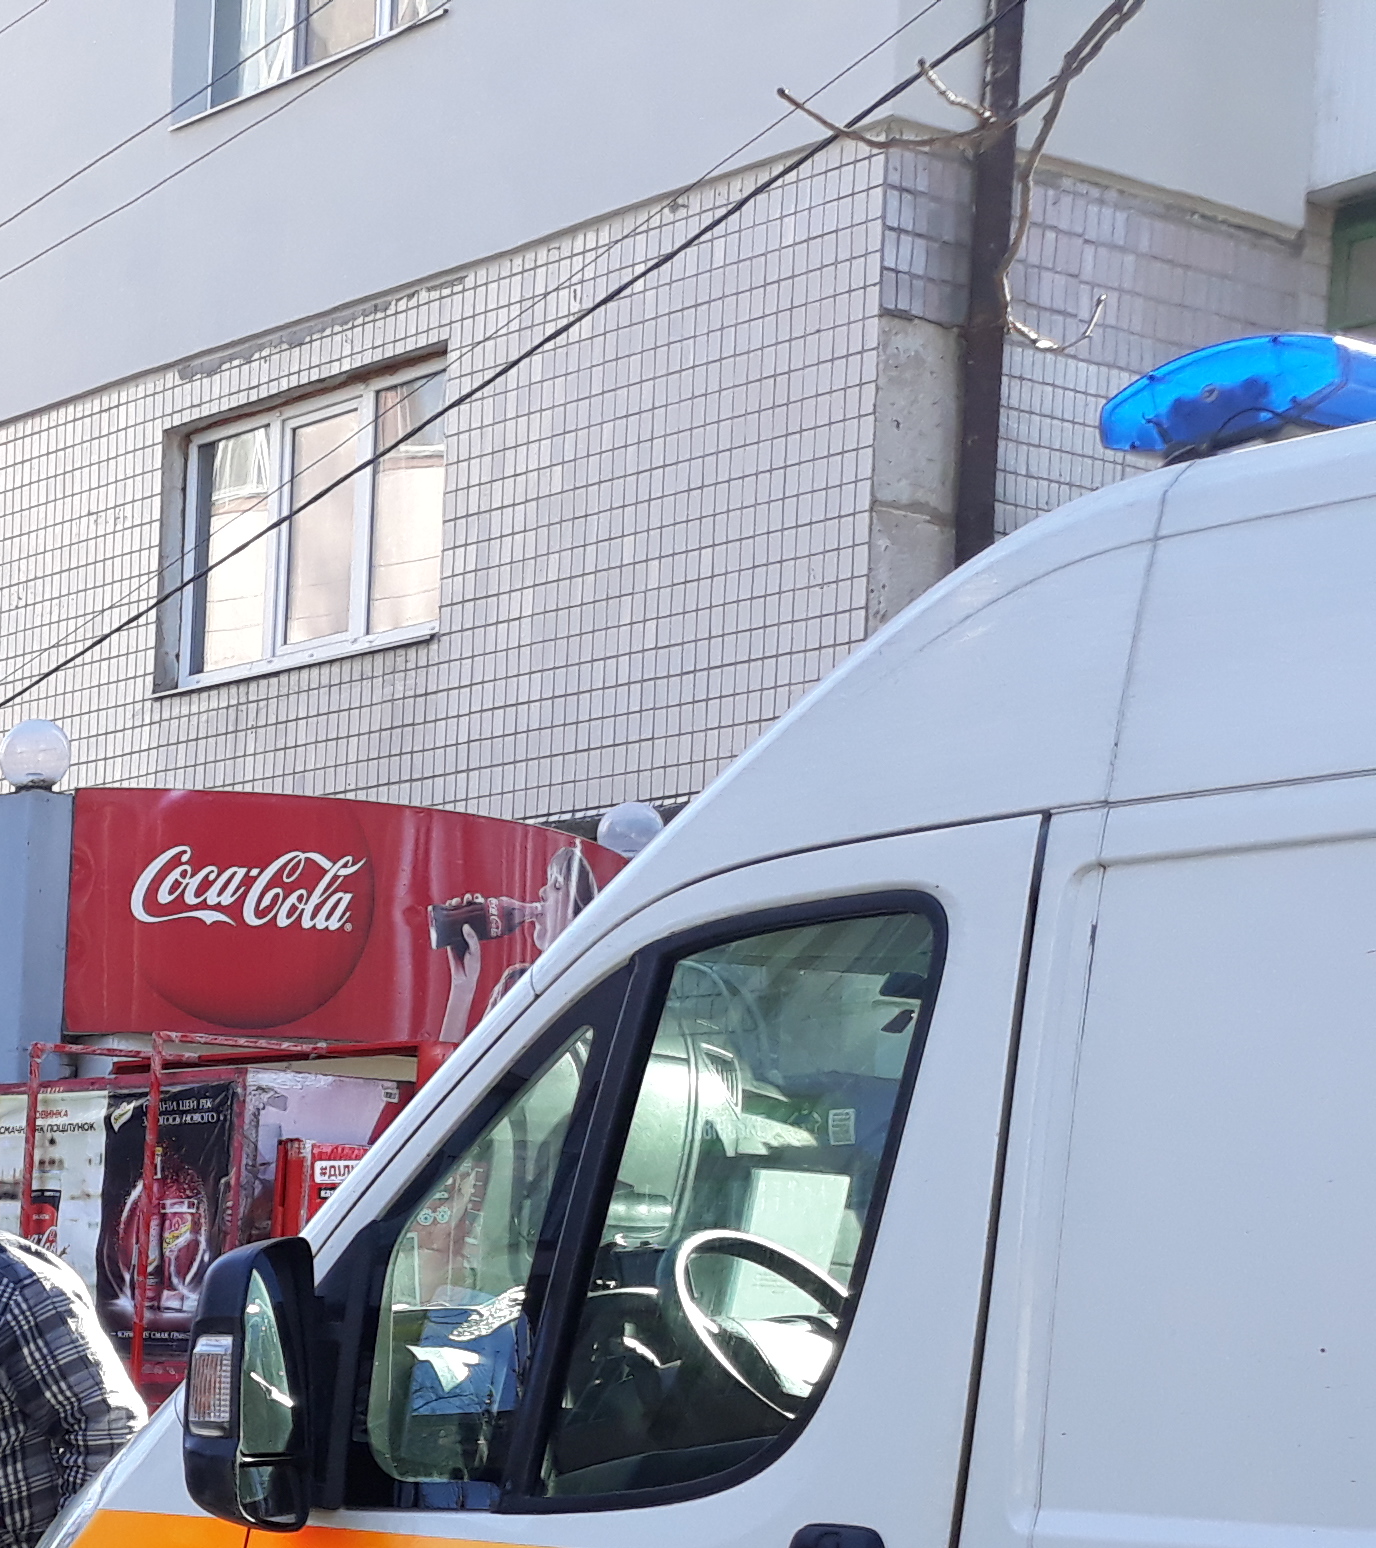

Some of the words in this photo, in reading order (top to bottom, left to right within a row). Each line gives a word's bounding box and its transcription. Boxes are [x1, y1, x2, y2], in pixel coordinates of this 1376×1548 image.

[130, 845, 366, 931] Coca-Cola
[36, 1109, 69, 1120] ОВИНКА
[0, 1125, 26, 1135] СМАЧН
[320, 1164, 355, 1179] #ДІЛ
